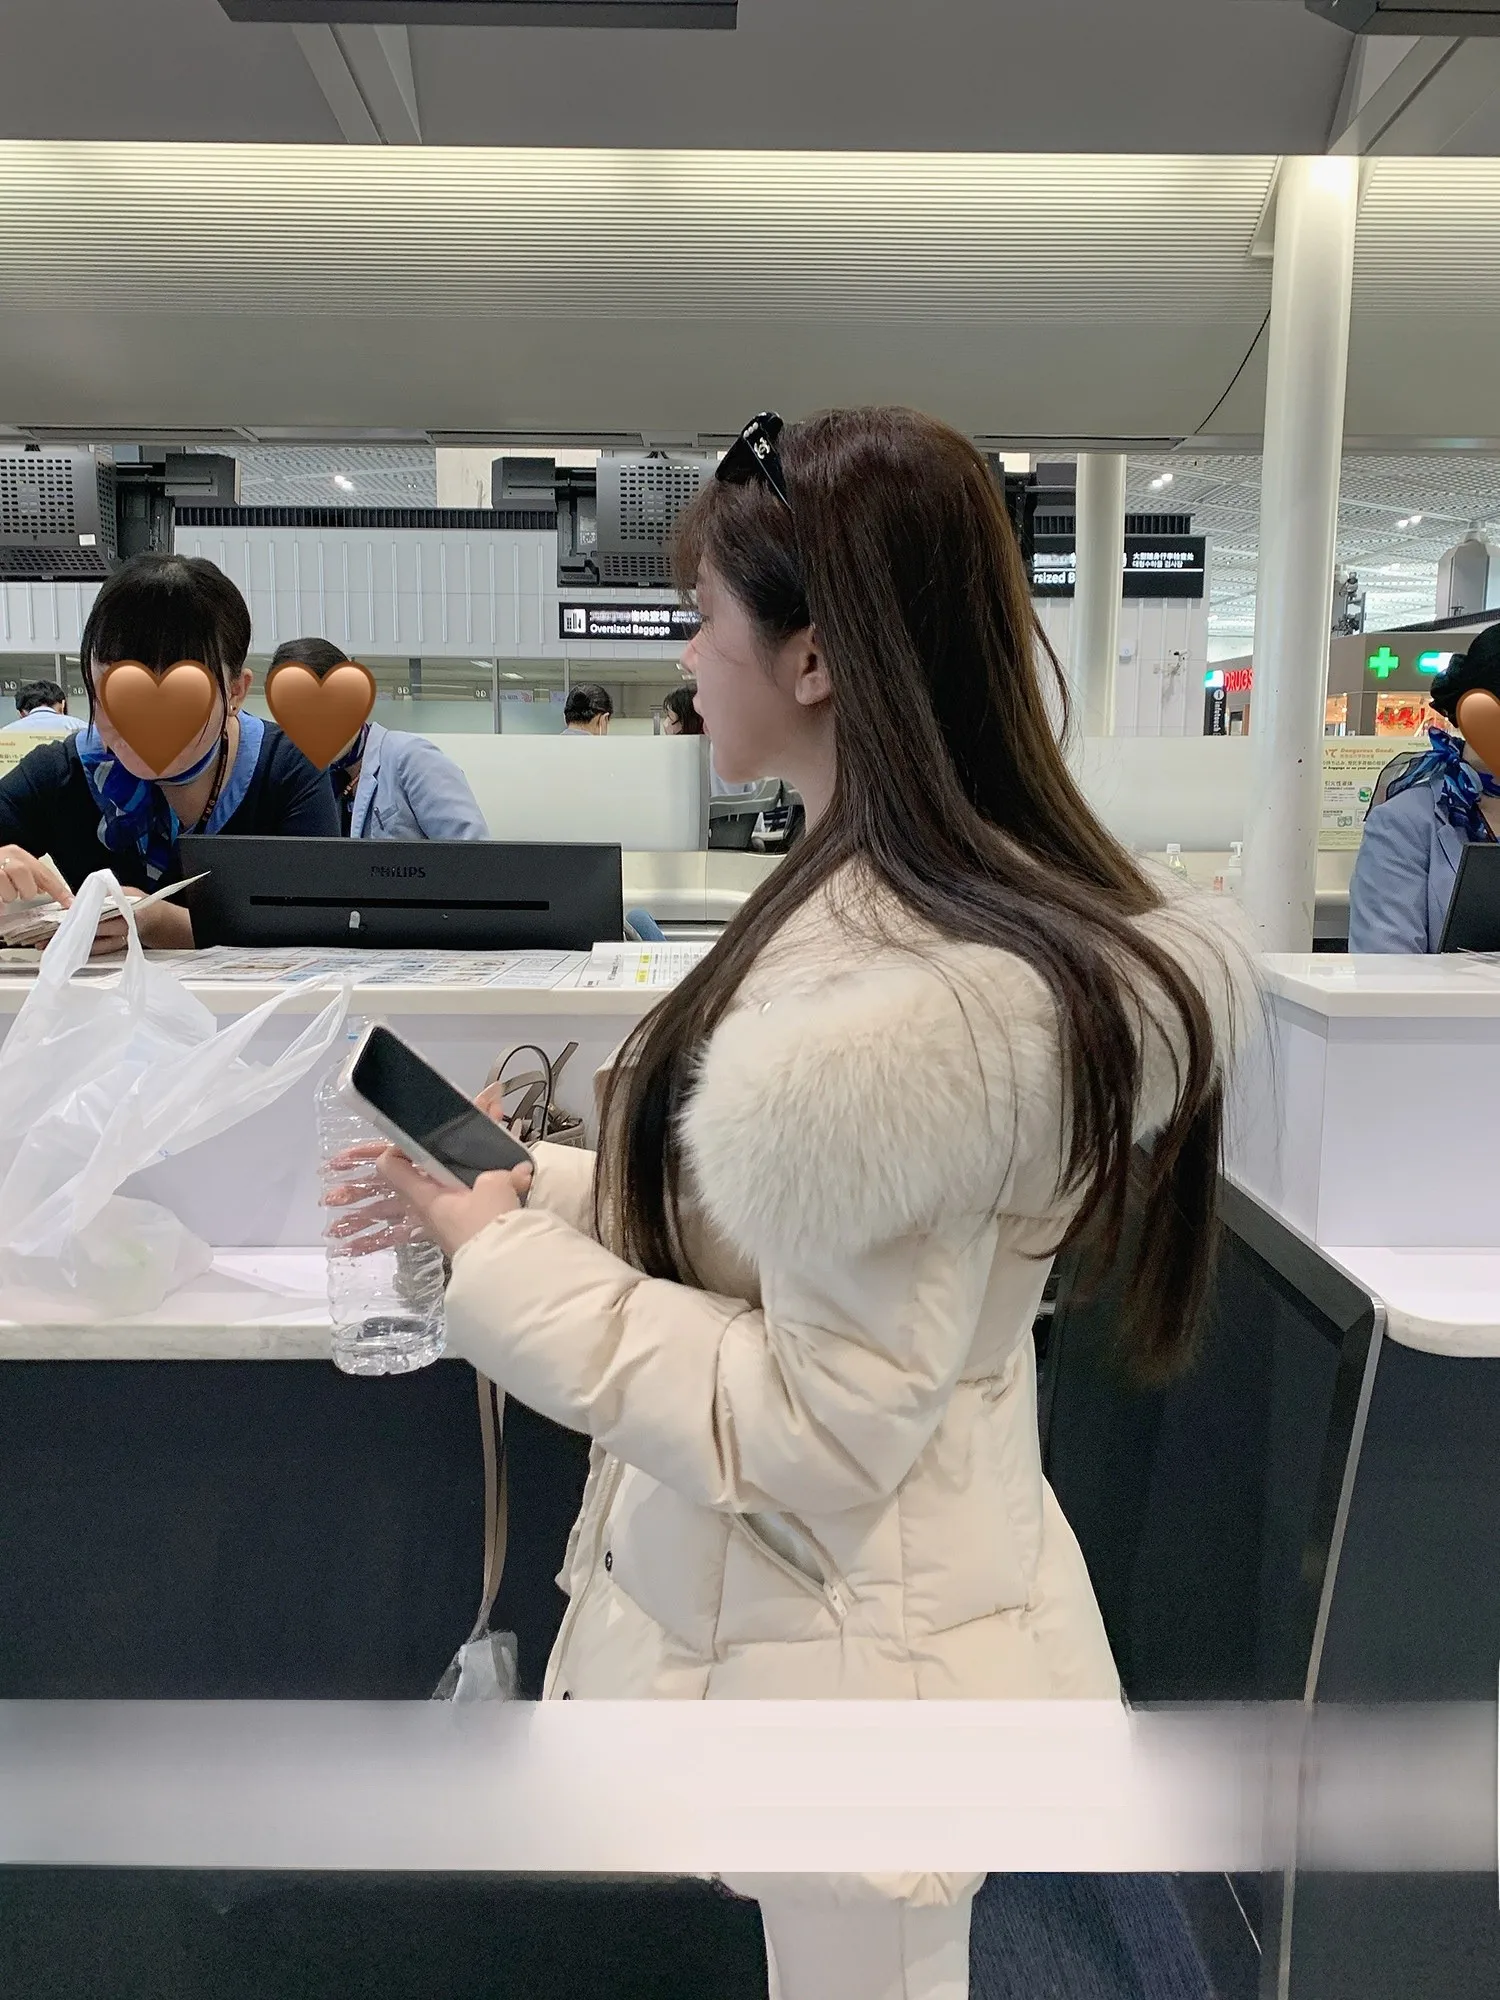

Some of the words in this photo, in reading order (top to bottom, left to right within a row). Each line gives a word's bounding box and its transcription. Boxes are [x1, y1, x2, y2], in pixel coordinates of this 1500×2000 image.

[1033, 572, 1066, 584] rsized
[589, 624, 631, 634] Oversized
[632, 624, 671, 636] Baggage
[370, 865, 426, 878] PHILIPS
